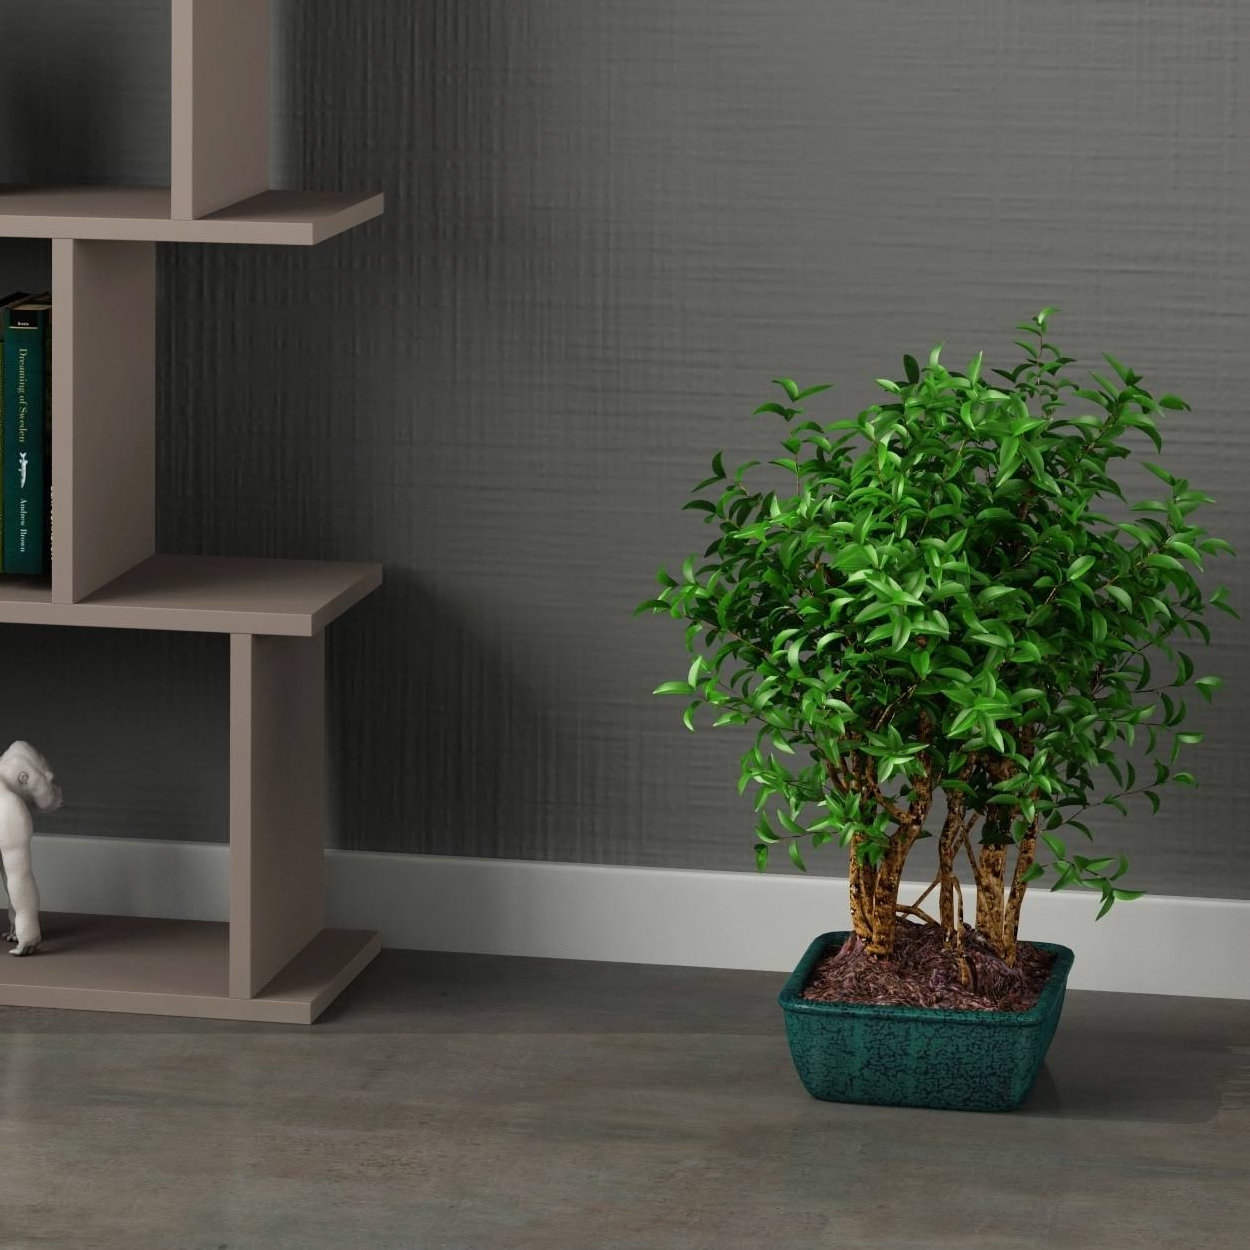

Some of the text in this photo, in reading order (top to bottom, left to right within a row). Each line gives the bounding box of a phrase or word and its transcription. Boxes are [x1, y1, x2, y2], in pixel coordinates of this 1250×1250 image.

[17, 348, 28, 443] Dreaming of Sweden
[20, 498, 28, 552] Andrew Brown
